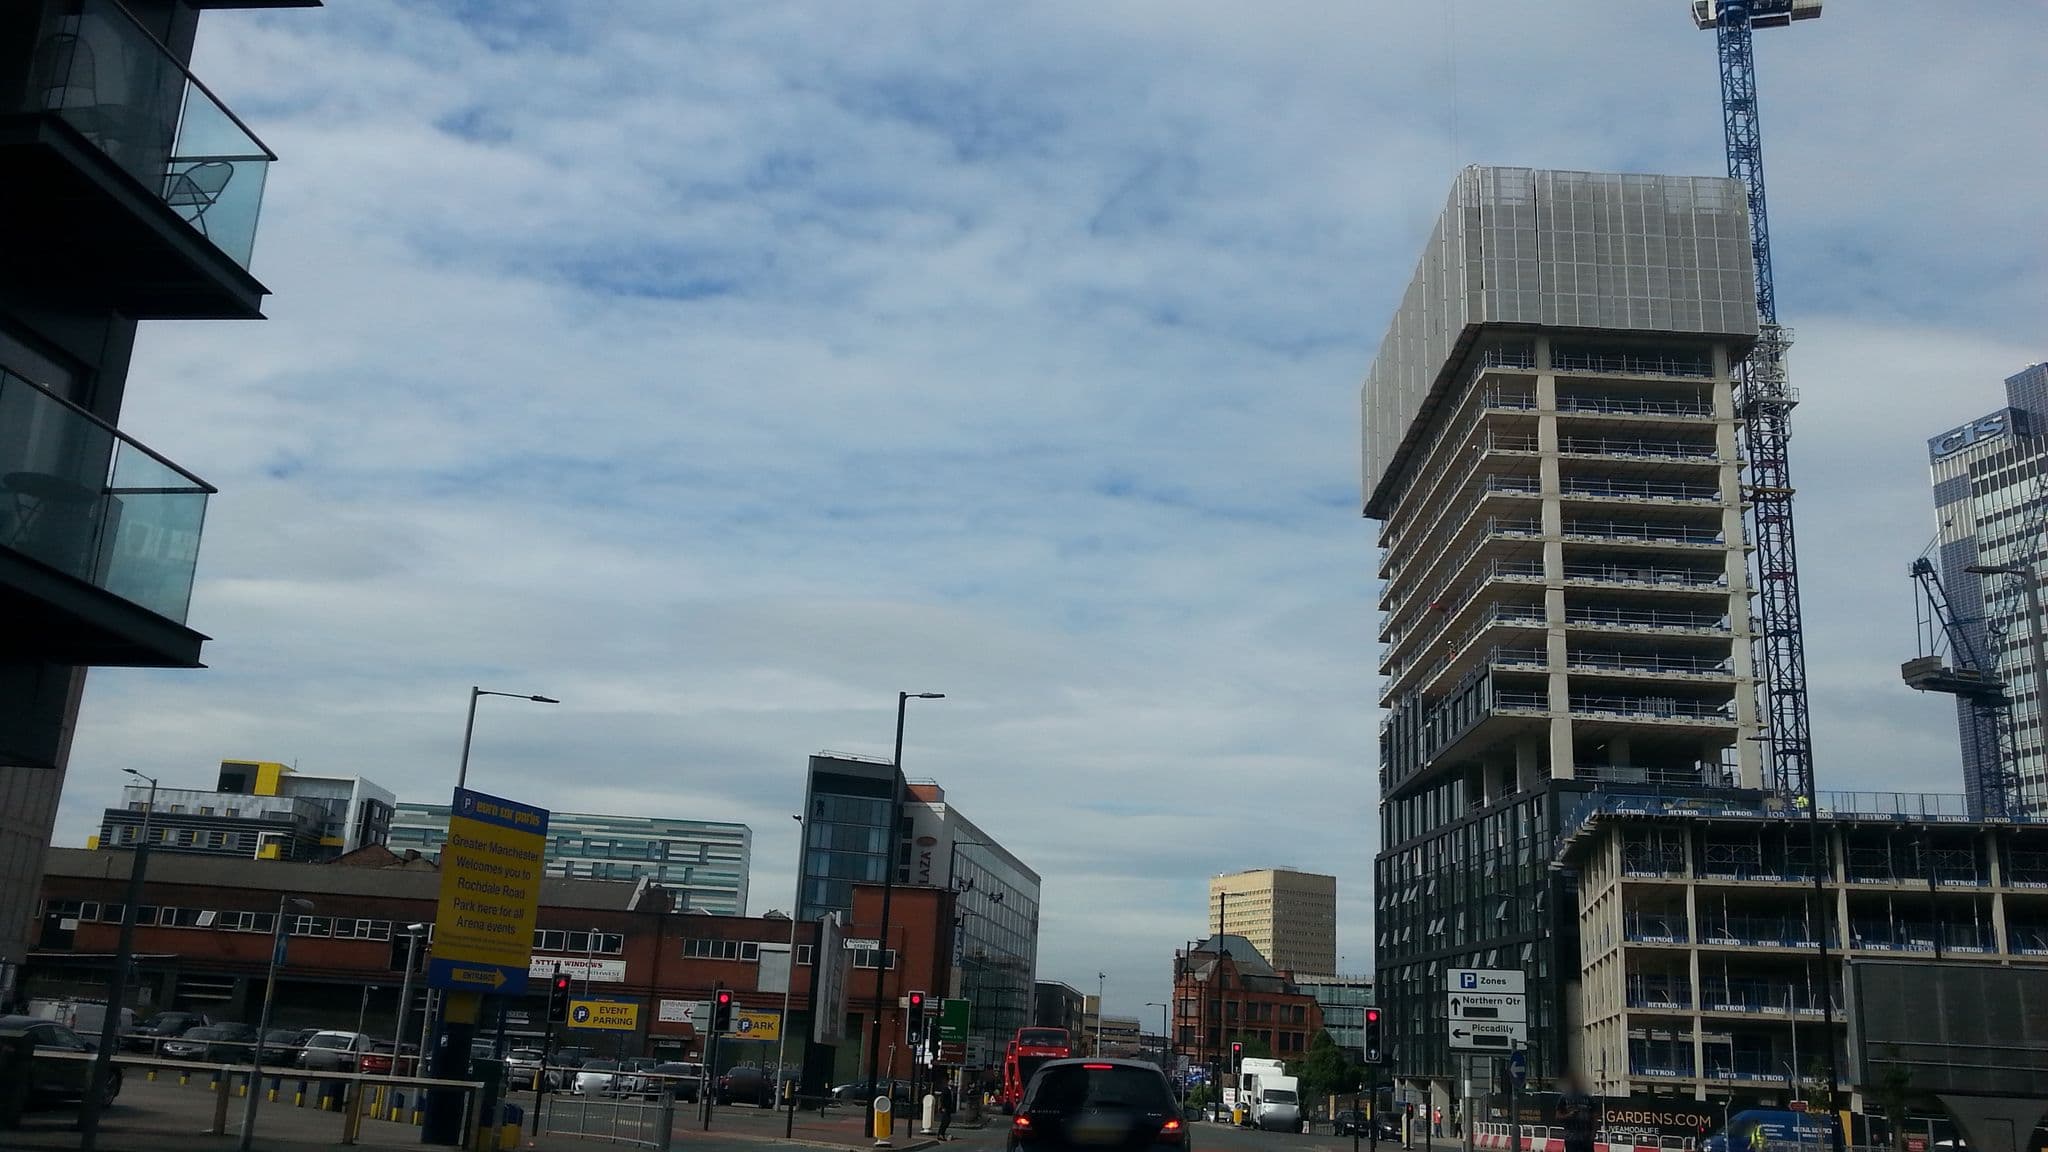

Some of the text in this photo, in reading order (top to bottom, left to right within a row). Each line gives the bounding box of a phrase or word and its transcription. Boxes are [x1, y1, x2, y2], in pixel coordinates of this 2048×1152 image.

[476, 800, 498, 816] euro
[500, 807, 513, 819] car
[515, 811, 540, 825] parks
[453, 834, 538, 862] Greater Manchester
[456, 856, 531, 881] Welcomes you to
[918, 851, 931, 884] LAZA
[457, 876, 525, 899] Rochdale Road
[453, 897, 524, 919] Park here for all
[456, 915, 516, 934] Arena events
[564, 960, 603, 969] WINDOWS
[1464, 974, 1507, 987] P Zones
[1462, 996, 1521, 1005] Northern Qtr
[599, 1006, 629, 1015] EVENT
[592, 1016, 633, 1026] PARKING
[1472, 1024, 1514, 1034] Piccadilly
[1645, 1068, 1676, 1076] HEYROD
[1605, 1110, 1712, 1128] GARDENS.COM
